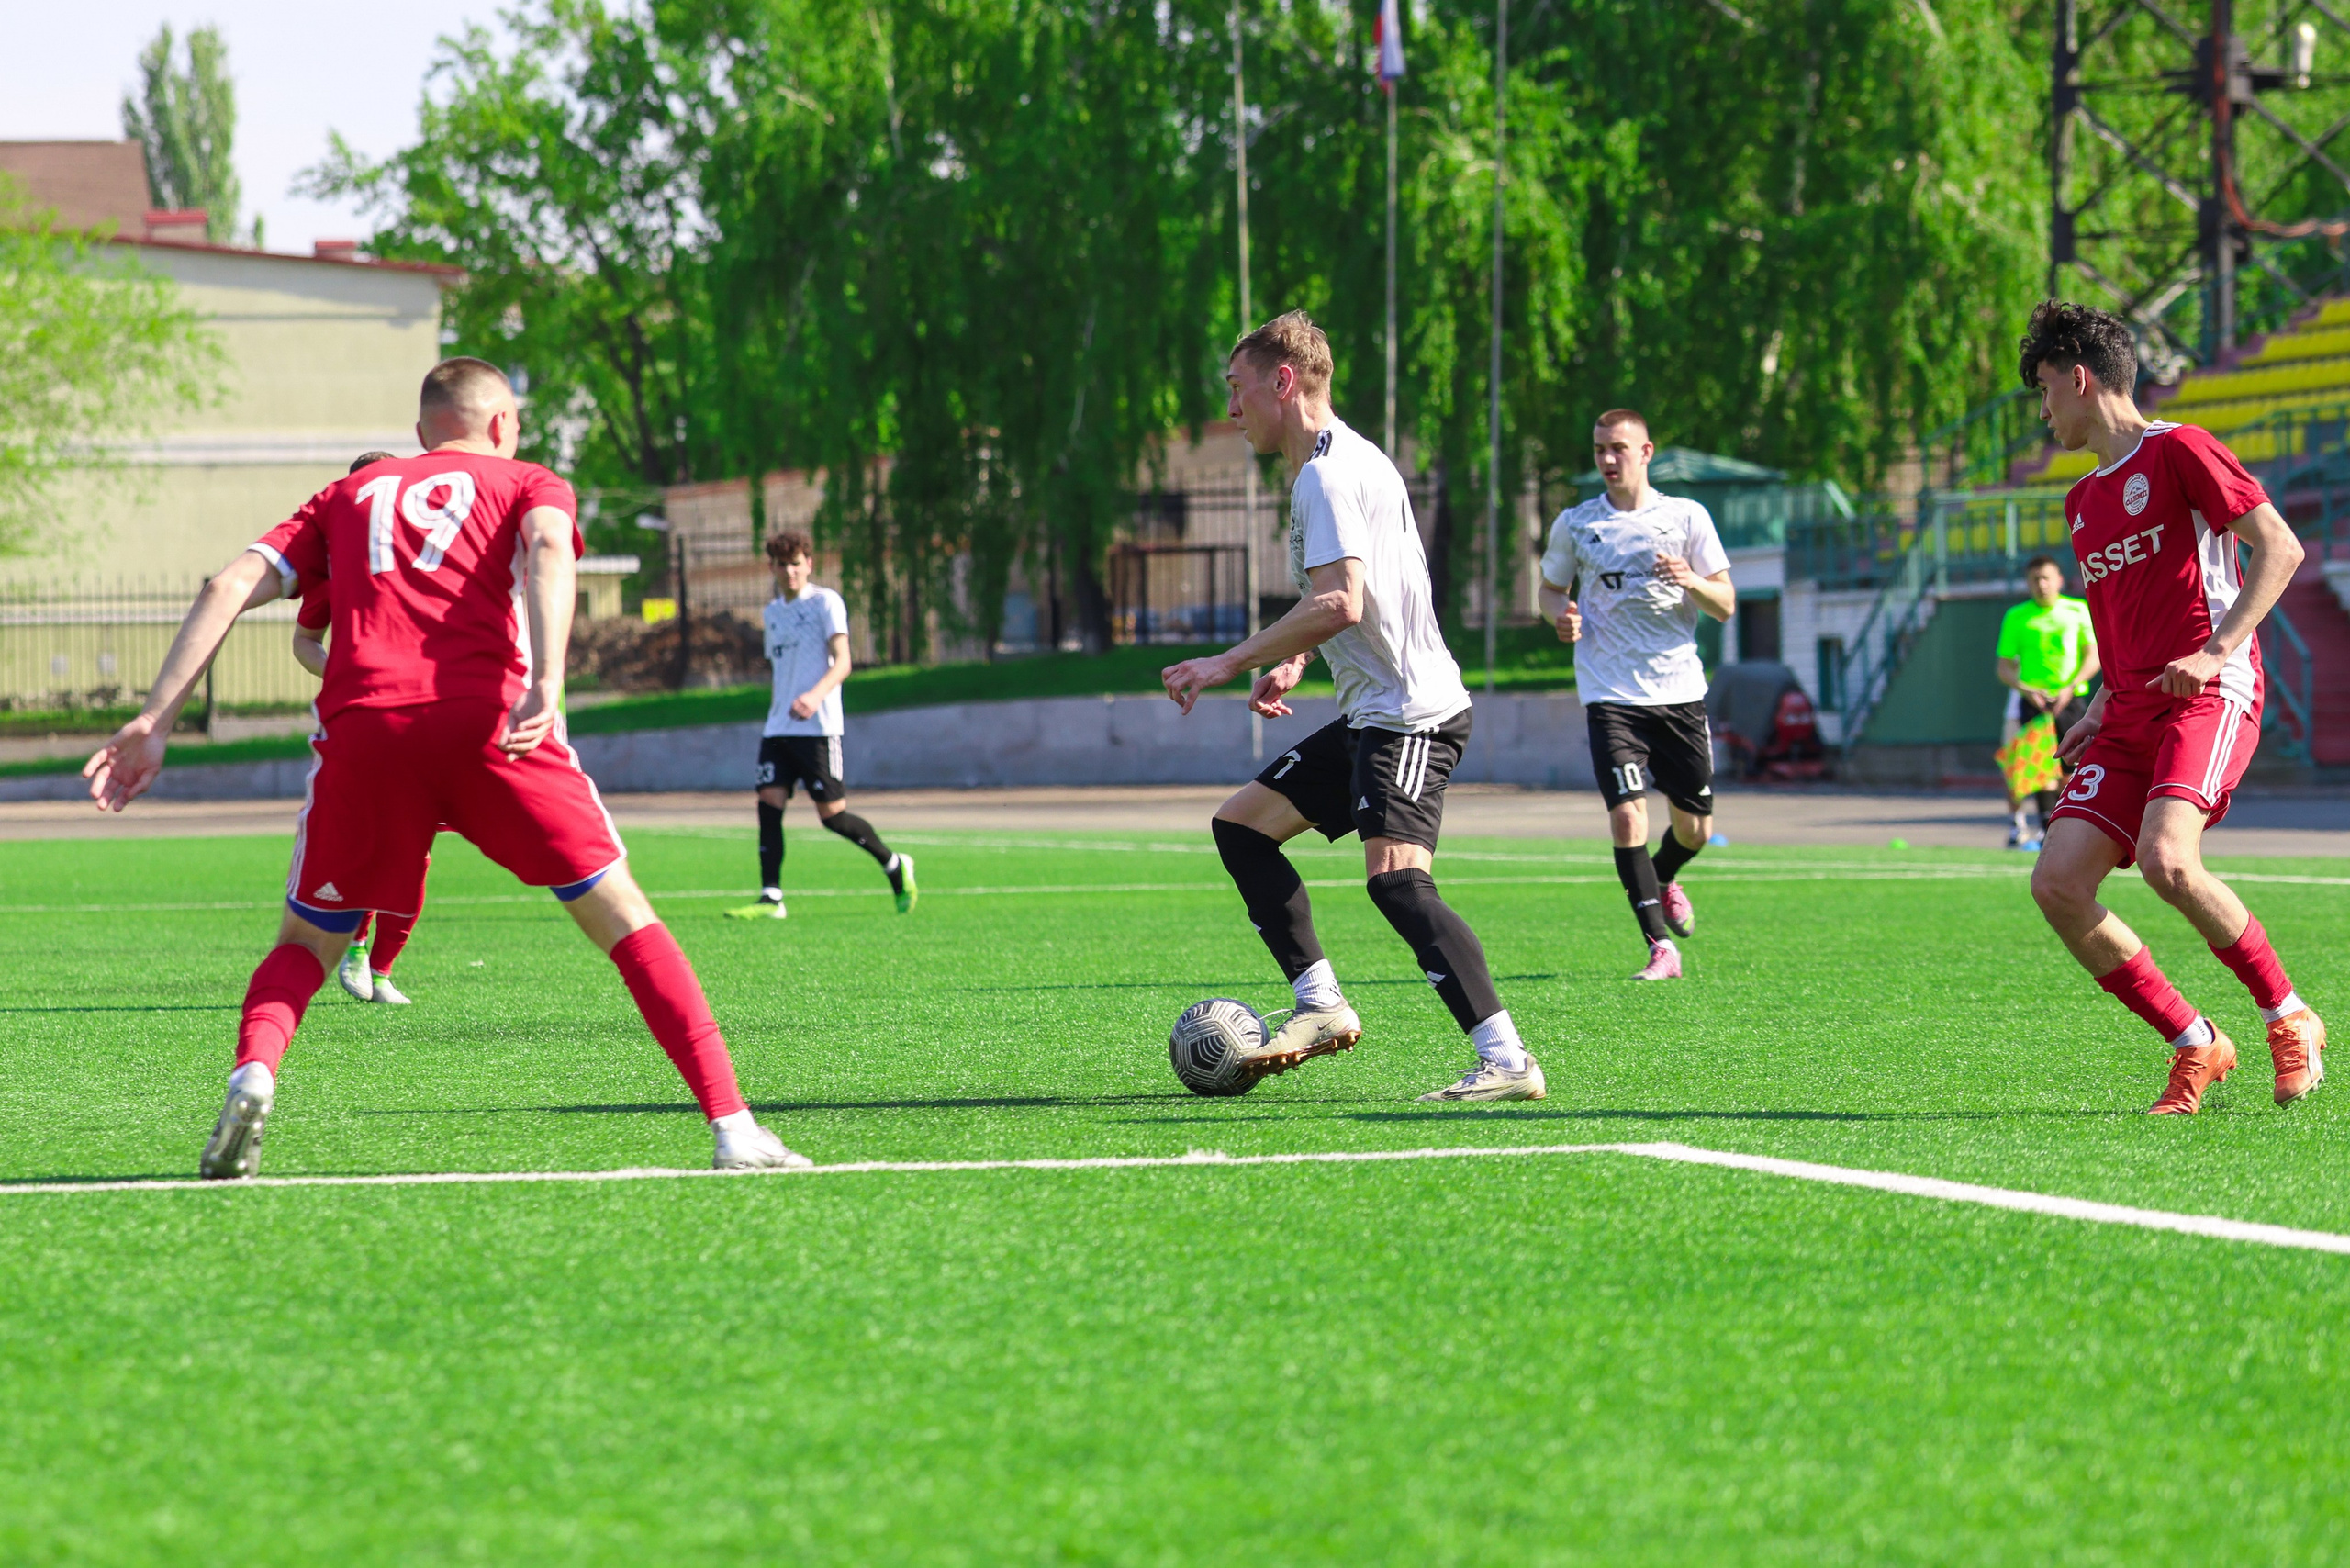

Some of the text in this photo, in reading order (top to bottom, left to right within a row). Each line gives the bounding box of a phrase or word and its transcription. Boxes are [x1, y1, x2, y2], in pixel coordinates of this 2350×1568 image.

[355, 471, 476, 576] 19
[2079, 523, 2165, 589] ASSET
[1612, 762, 1643, 796] 10
